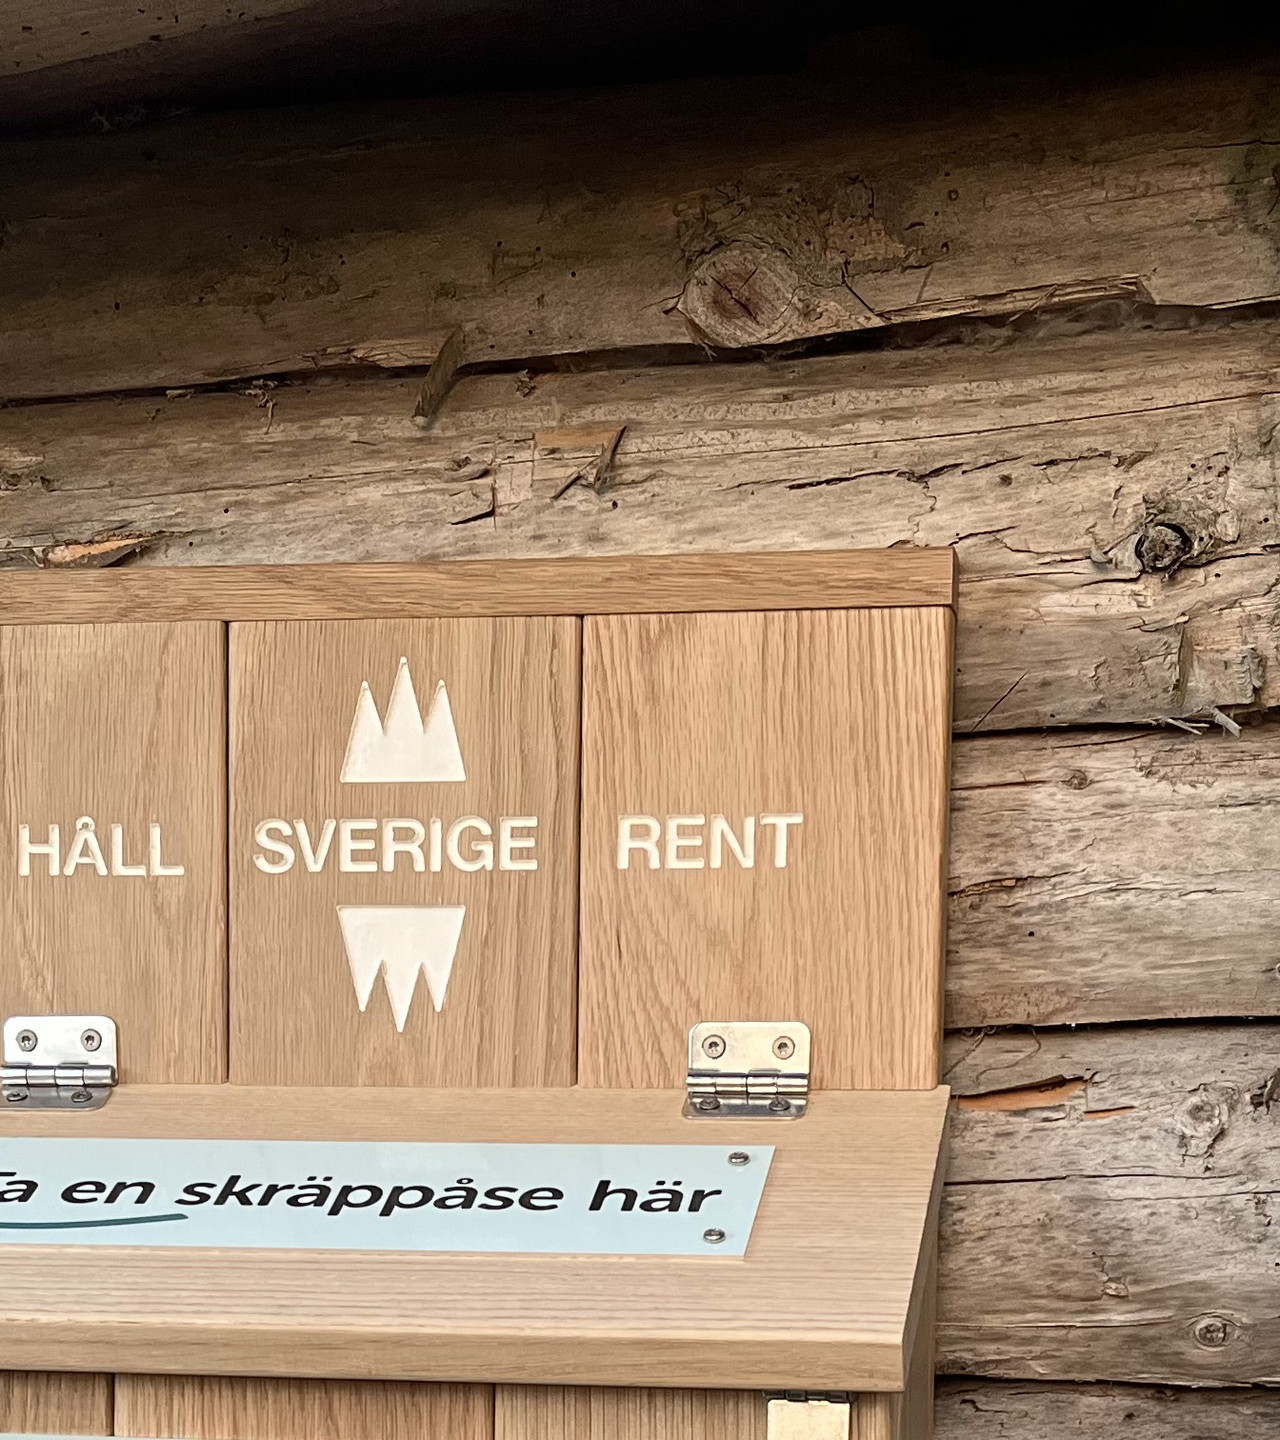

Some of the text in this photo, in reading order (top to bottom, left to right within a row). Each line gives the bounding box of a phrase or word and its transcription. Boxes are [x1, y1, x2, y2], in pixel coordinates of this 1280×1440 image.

[17, 812, 803, 878] HÅLL SVERIGE RENT
[59, 1178, 157, 1207] en
[175, 1174, 565, 1218] skräppåse
[588, 1176, 723, 1216] här
